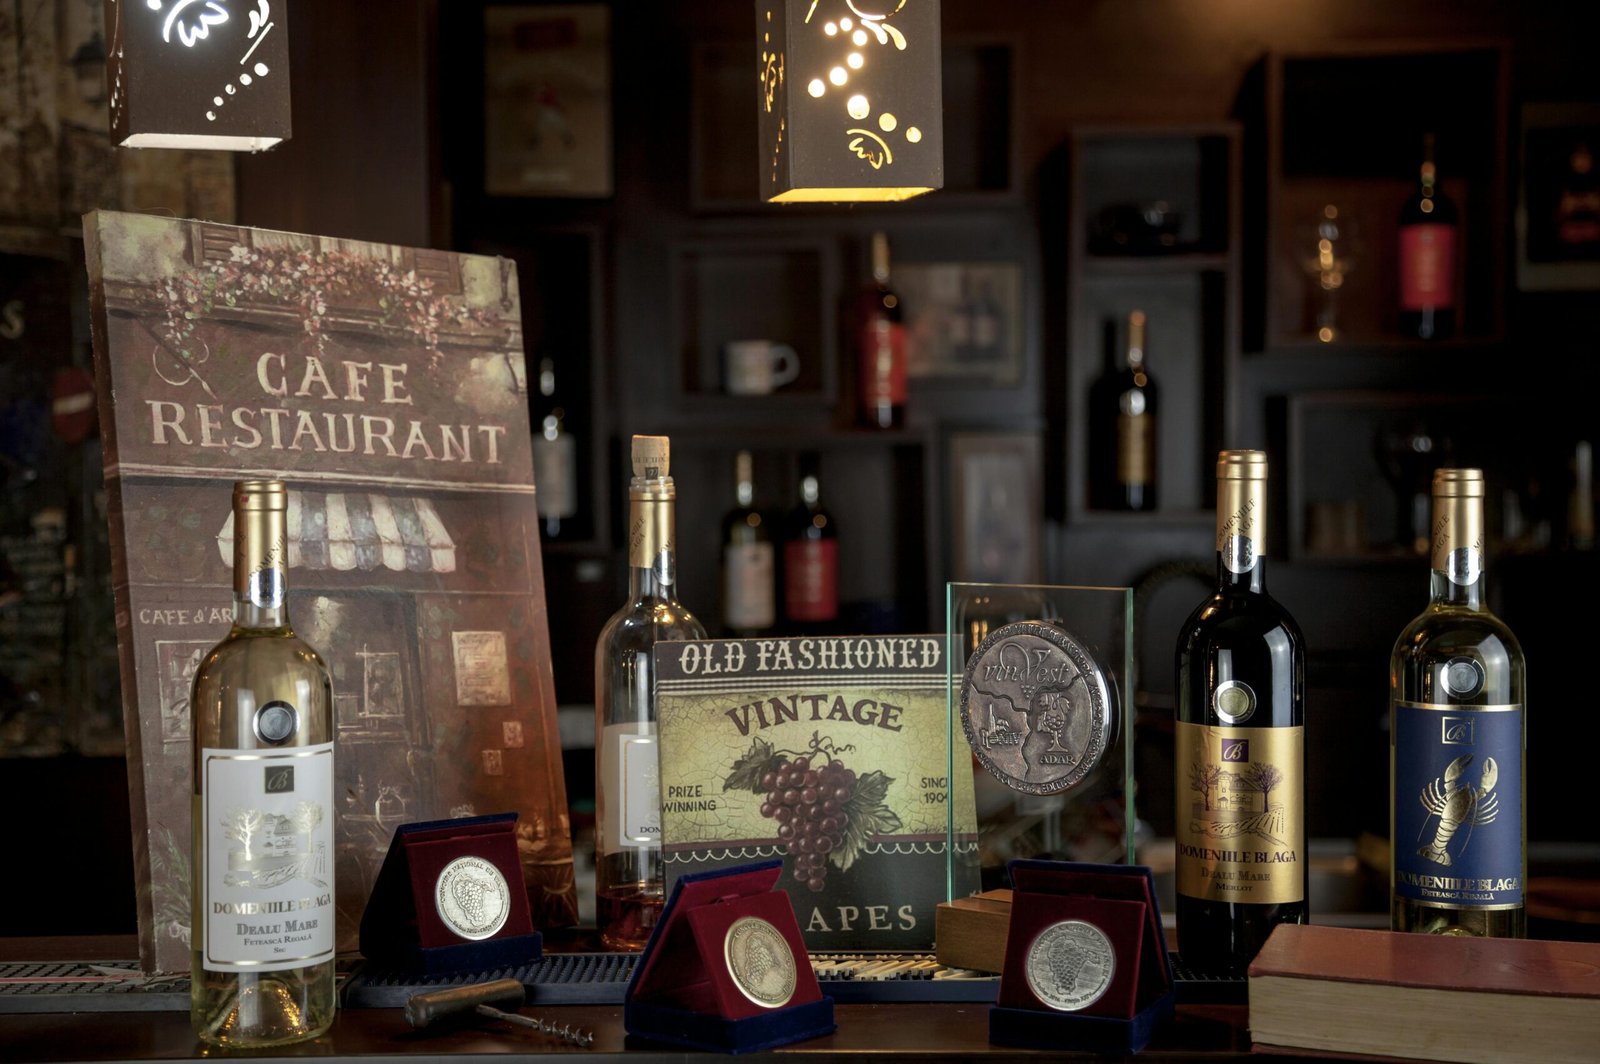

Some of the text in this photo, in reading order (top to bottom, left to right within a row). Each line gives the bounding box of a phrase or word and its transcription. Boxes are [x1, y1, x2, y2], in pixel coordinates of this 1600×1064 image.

[256, 352, 414, 406] CAFE
[145, 399, 507, 464] RESTAURANT
[140, 608, 190, 625] CAFE
[679, 638, 941, 675] OLD FASHIONED
[725, 694, 904, 736] VINTAGE
[1223, 741, 1248, 760] B
[1039, 753, 1077, 766] ADAR
[267, 768, 293, 791] B
[668, 784, 703, 798] PRIZE
[661, 800, 717, 813] WINNING
[1179, 843, 1297, 864] DOMENIILE BLAGA
[1215, 882, 1253, 892] MERLOT
[1477, 877, 1519, 892] BLAGA
[213, 901, 296, 914] DOMENIILE
[236, 919, 319, 935] DEALU MARE
